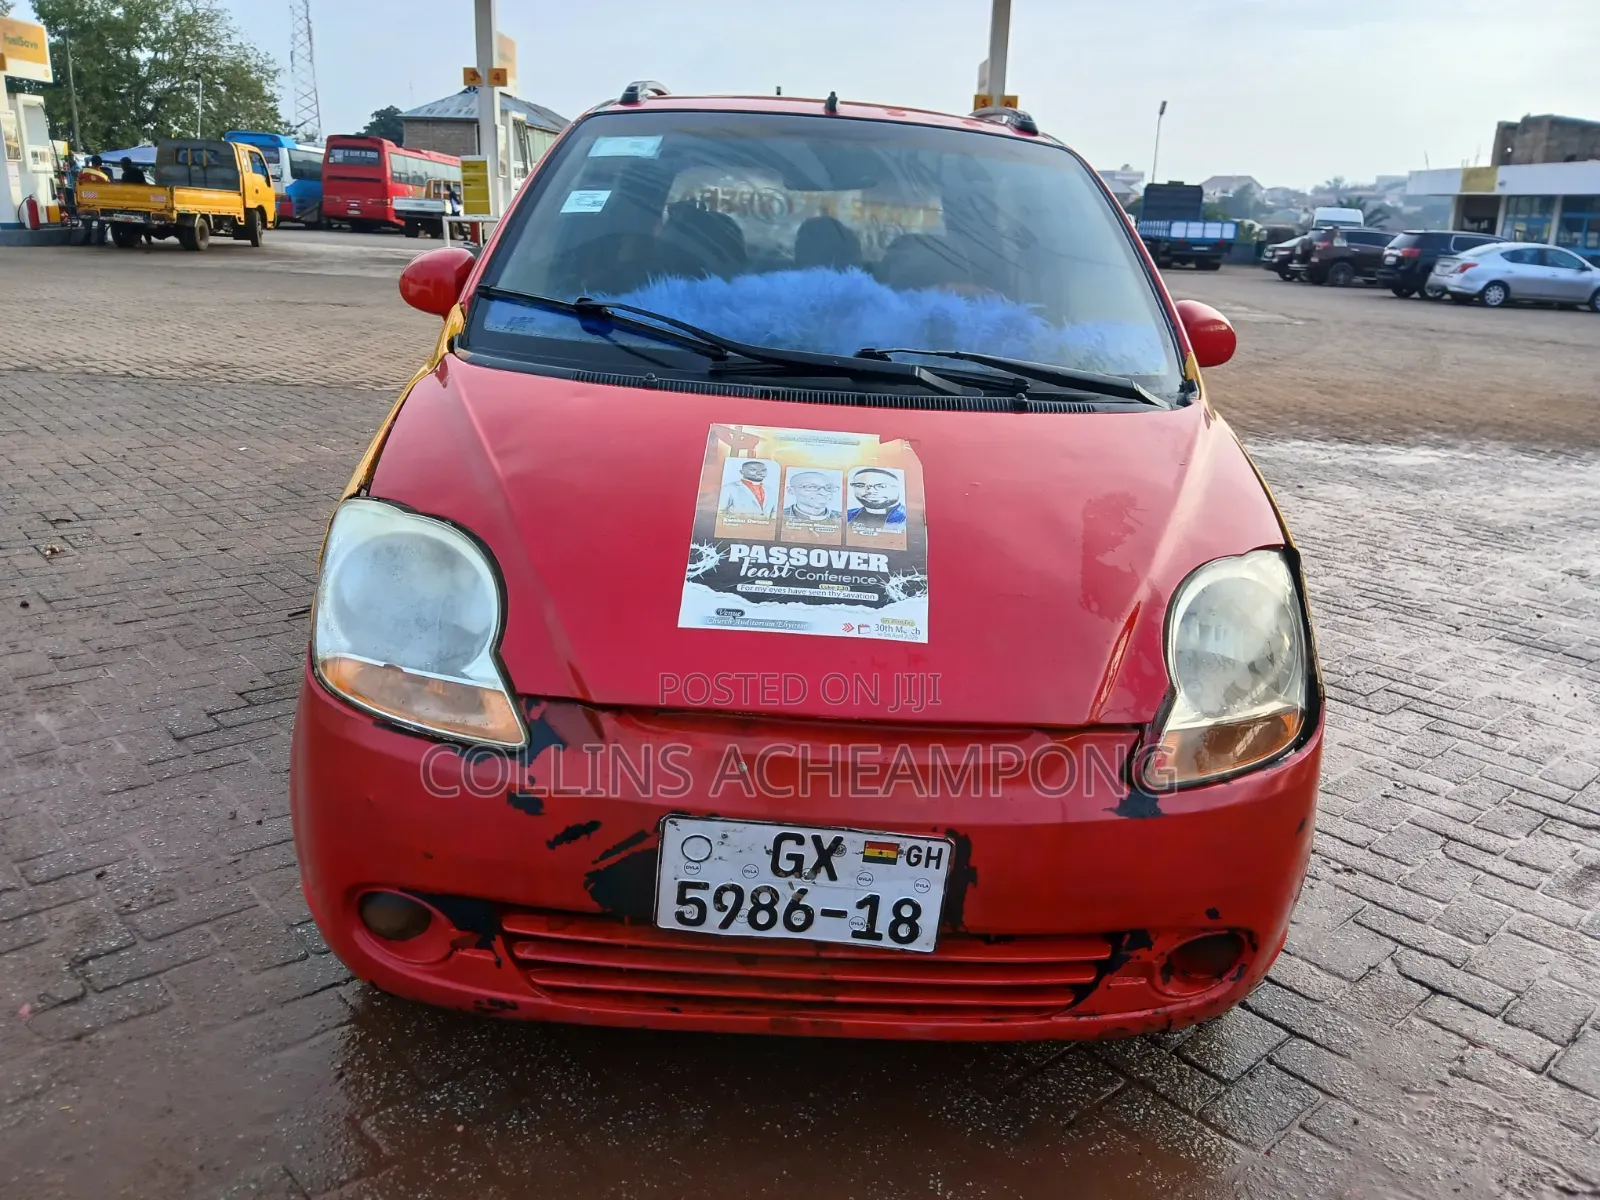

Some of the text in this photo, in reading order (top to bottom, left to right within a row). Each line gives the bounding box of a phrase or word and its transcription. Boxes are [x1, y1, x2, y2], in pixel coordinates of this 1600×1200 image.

[728, 543, 889, 573] PASSOVER
[739, 555, 878, 585] Feast Conference
[740, 584, 754, 592] For
[754, 586, 767, 594] my
[768, 587, 787, 596] eyes
[787, 587, 807, 595] have
[808, 589, 827, 597] seen
[828, 588, 842, 599] thy
[707, 617, 733, 626] Church
[732, 618, 776, 628] Auditorium
[717, 608, 742, 617] Venue
[874, 623, 921, 635] 30th Mch
[770, 831, 943, 882] GX GH
[675, 880, 922, 945] 5986-18
